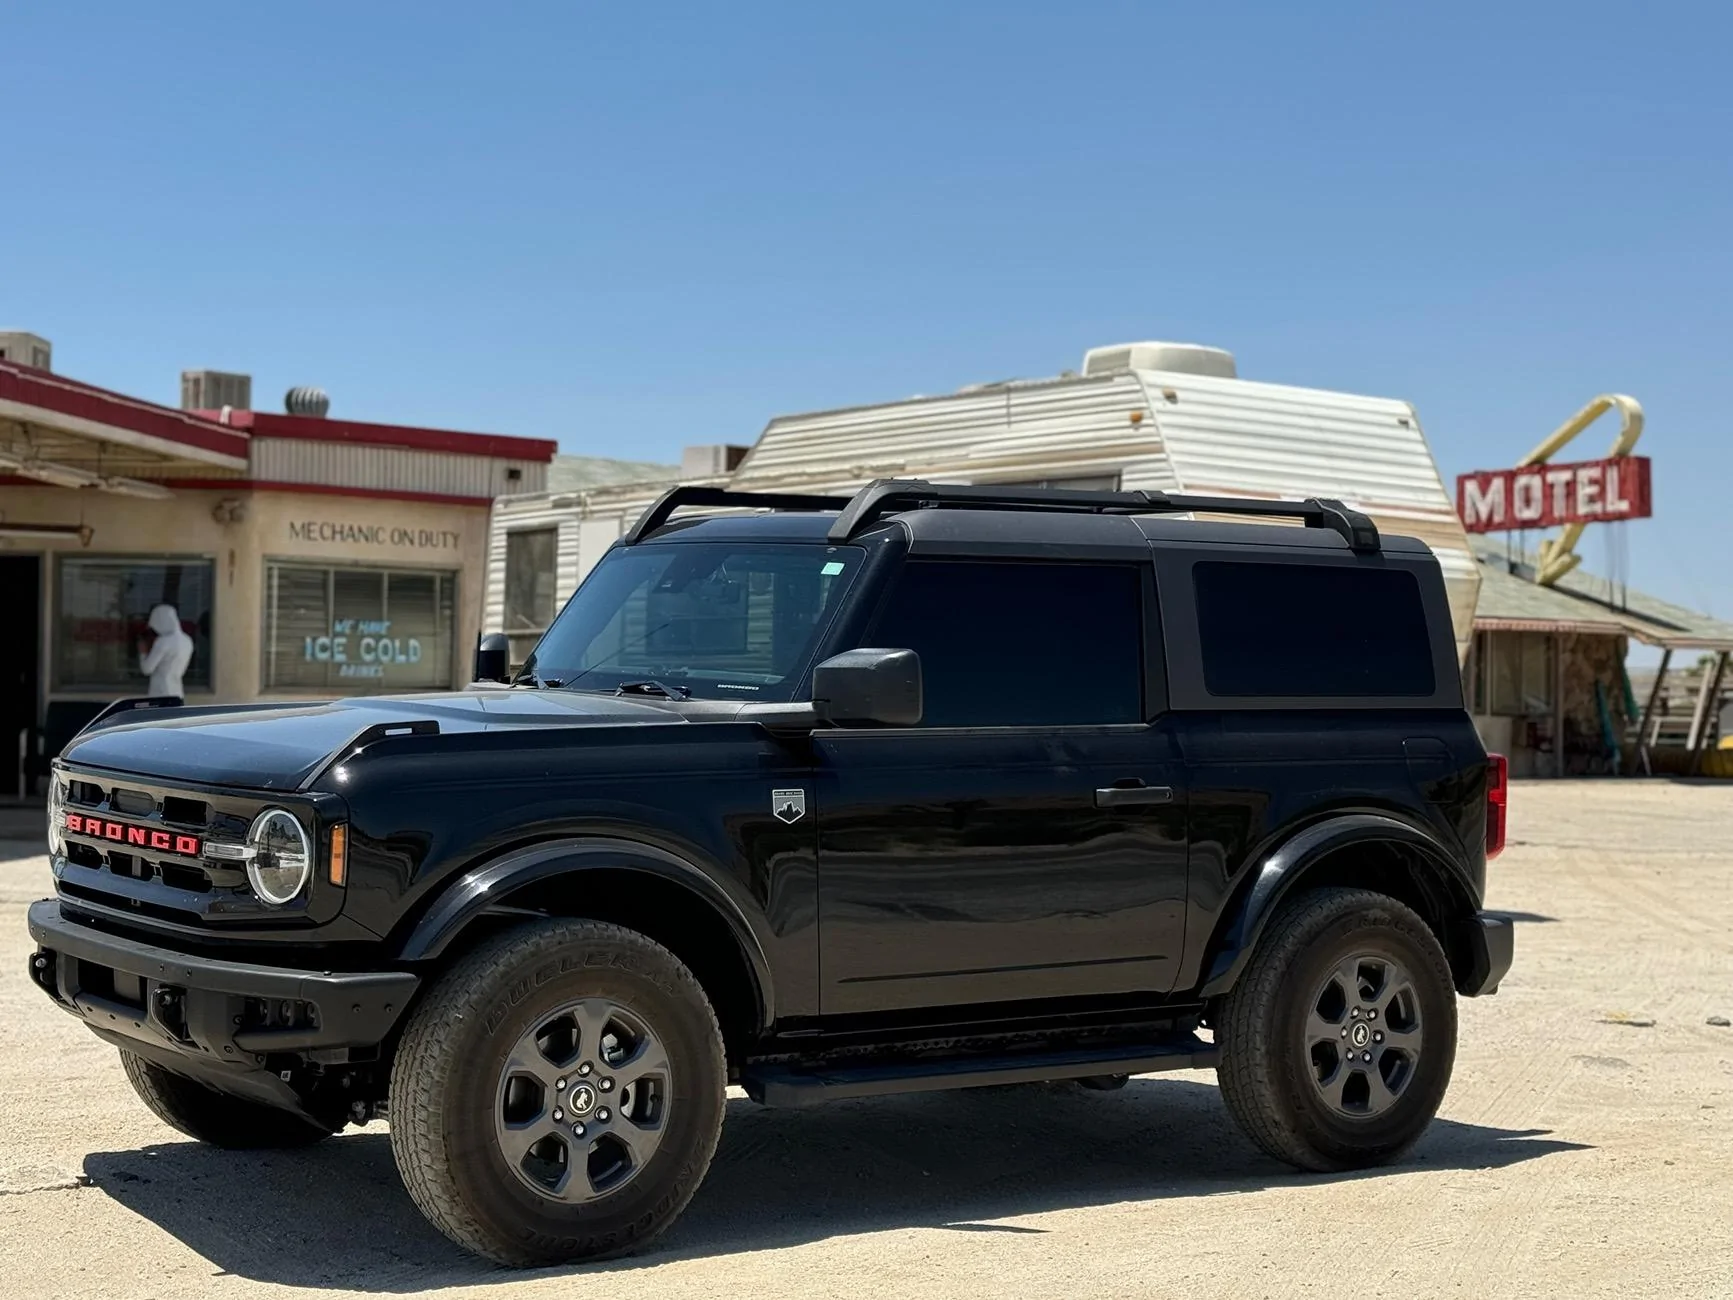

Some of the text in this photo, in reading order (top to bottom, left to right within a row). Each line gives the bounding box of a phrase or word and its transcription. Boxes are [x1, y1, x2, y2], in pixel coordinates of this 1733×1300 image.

[1463, 466, 1630, 525] MOTEL
[289, 521, 461, 551] MECHANIC ON DUTY
[304, 636, 421, 663] ICE COLD
[66, 815, 198, 855] BRONCO
